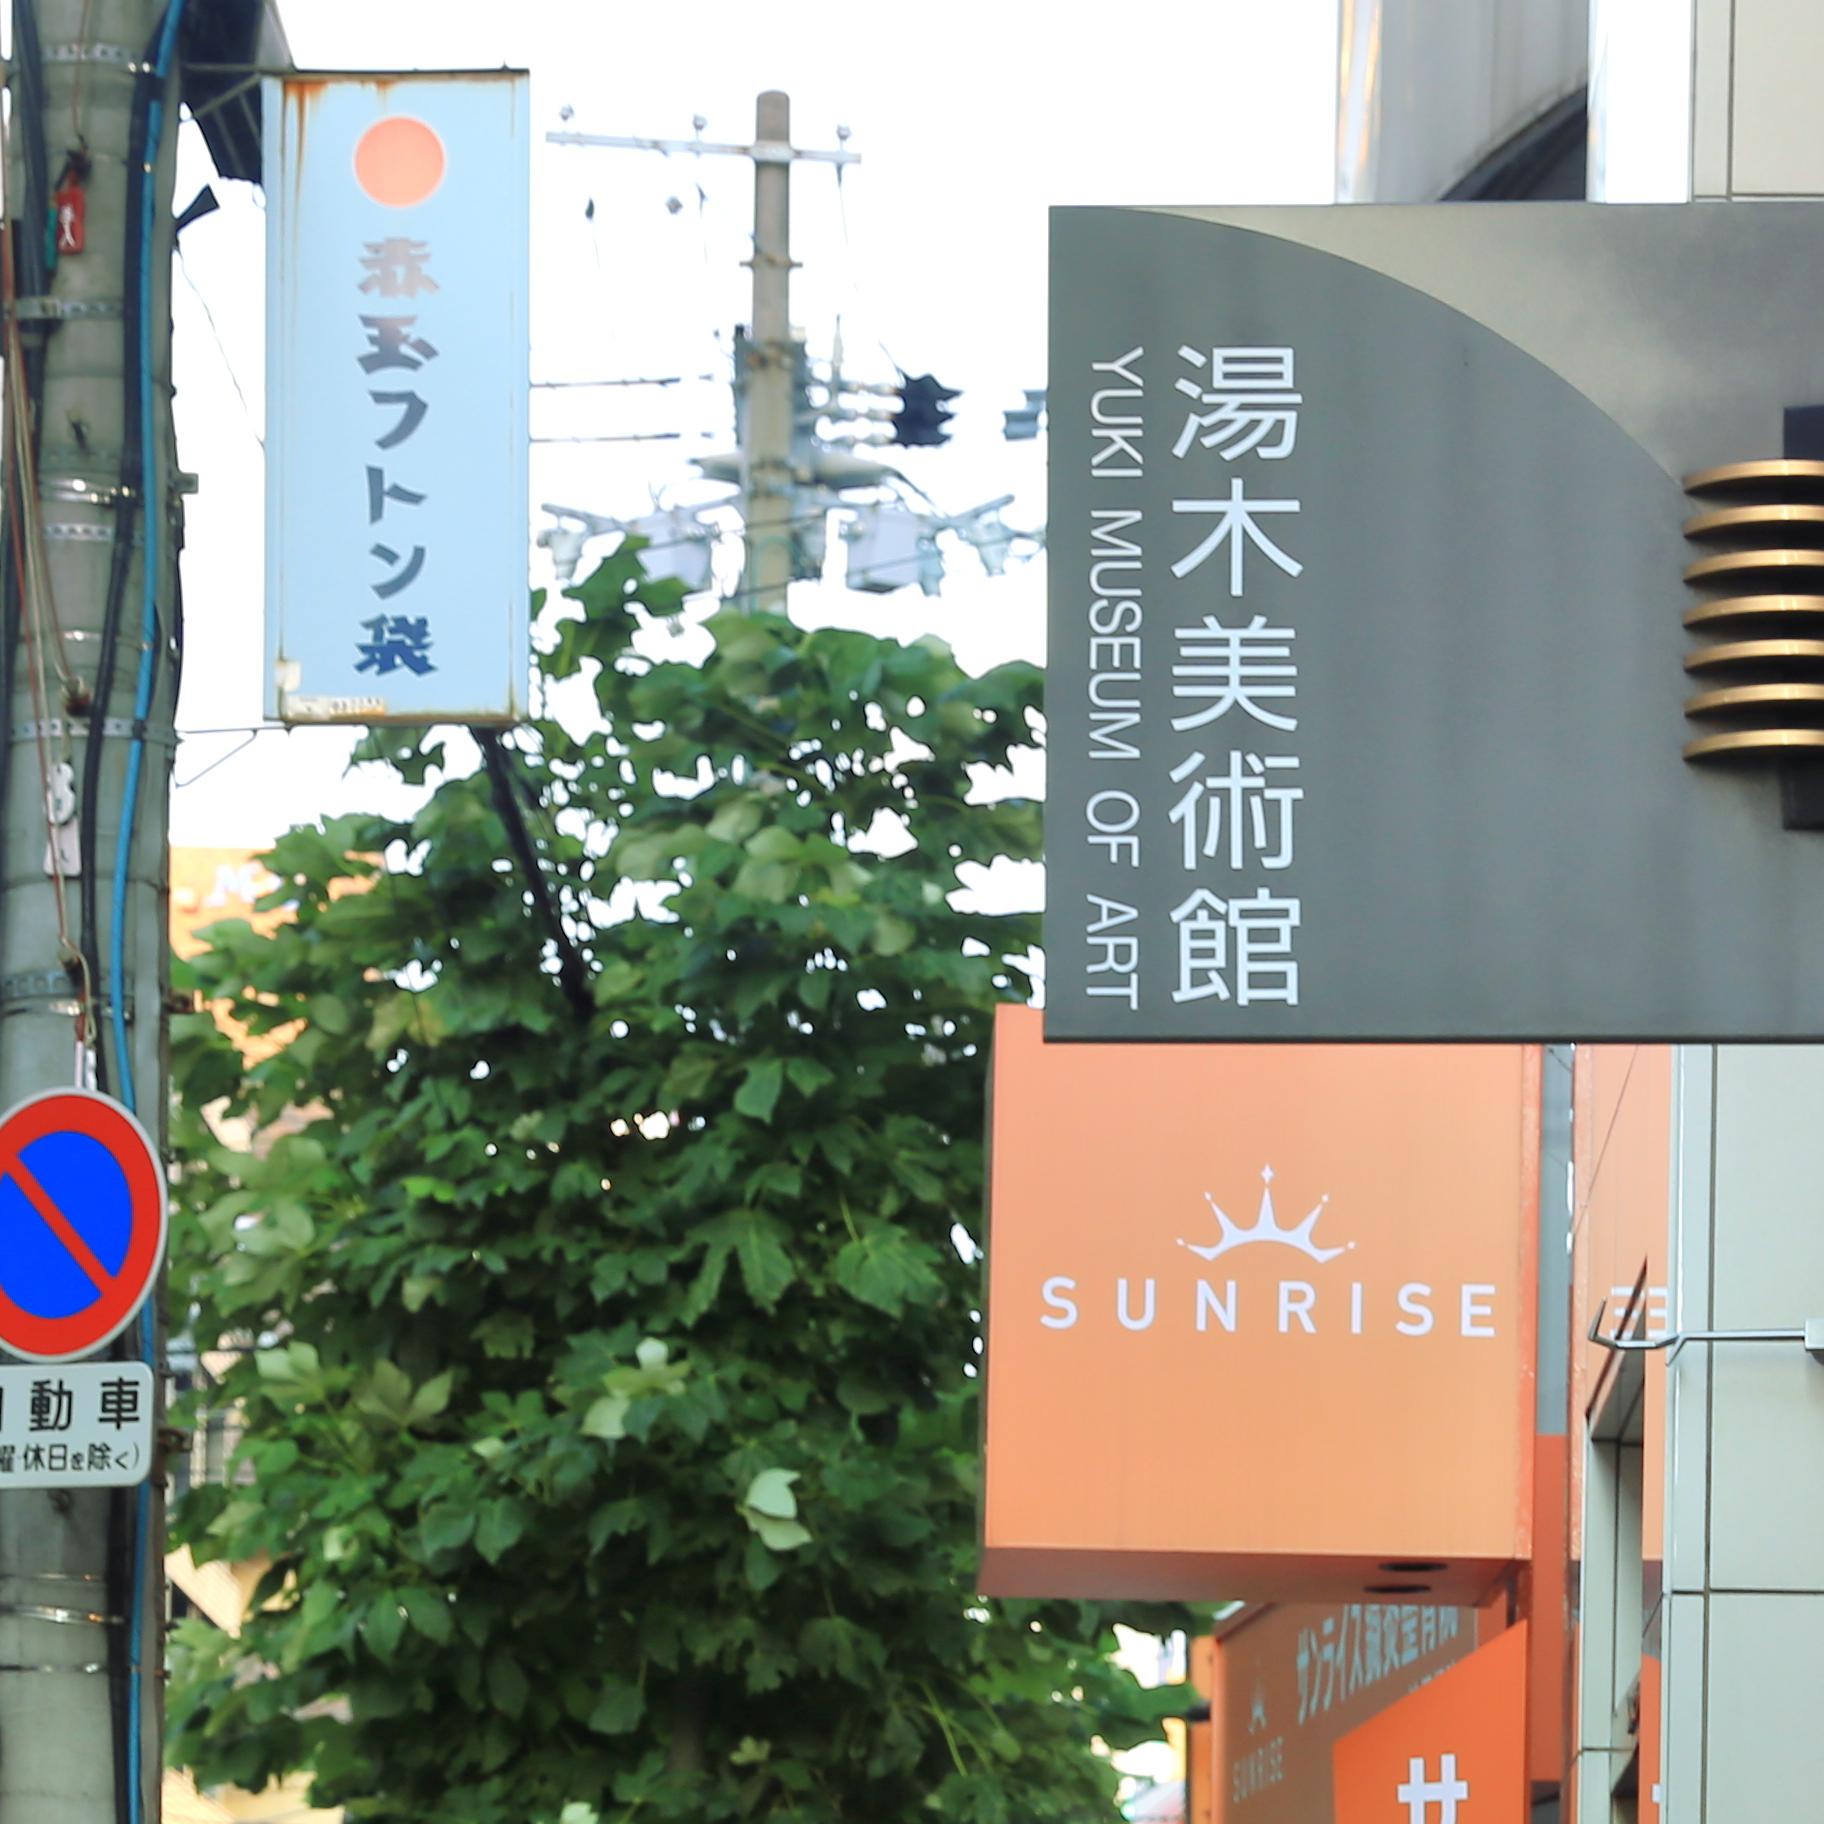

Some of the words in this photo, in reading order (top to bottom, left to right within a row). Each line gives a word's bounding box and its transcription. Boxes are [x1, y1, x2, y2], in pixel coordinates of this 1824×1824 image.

[355, 237, 440, 677] 赤玉フトン袋
[1091, 346, 1144, 479] YUKI
[1088, 508, 1143, 761] MUSEUM
[1169, 344, 1303, 1006] 湯木美術館
[1086, 790, 1141, 868] OF
[1085, 893, 1140, 1010] ART
[1039, 1275, 1497, 1337] SUNRISE
